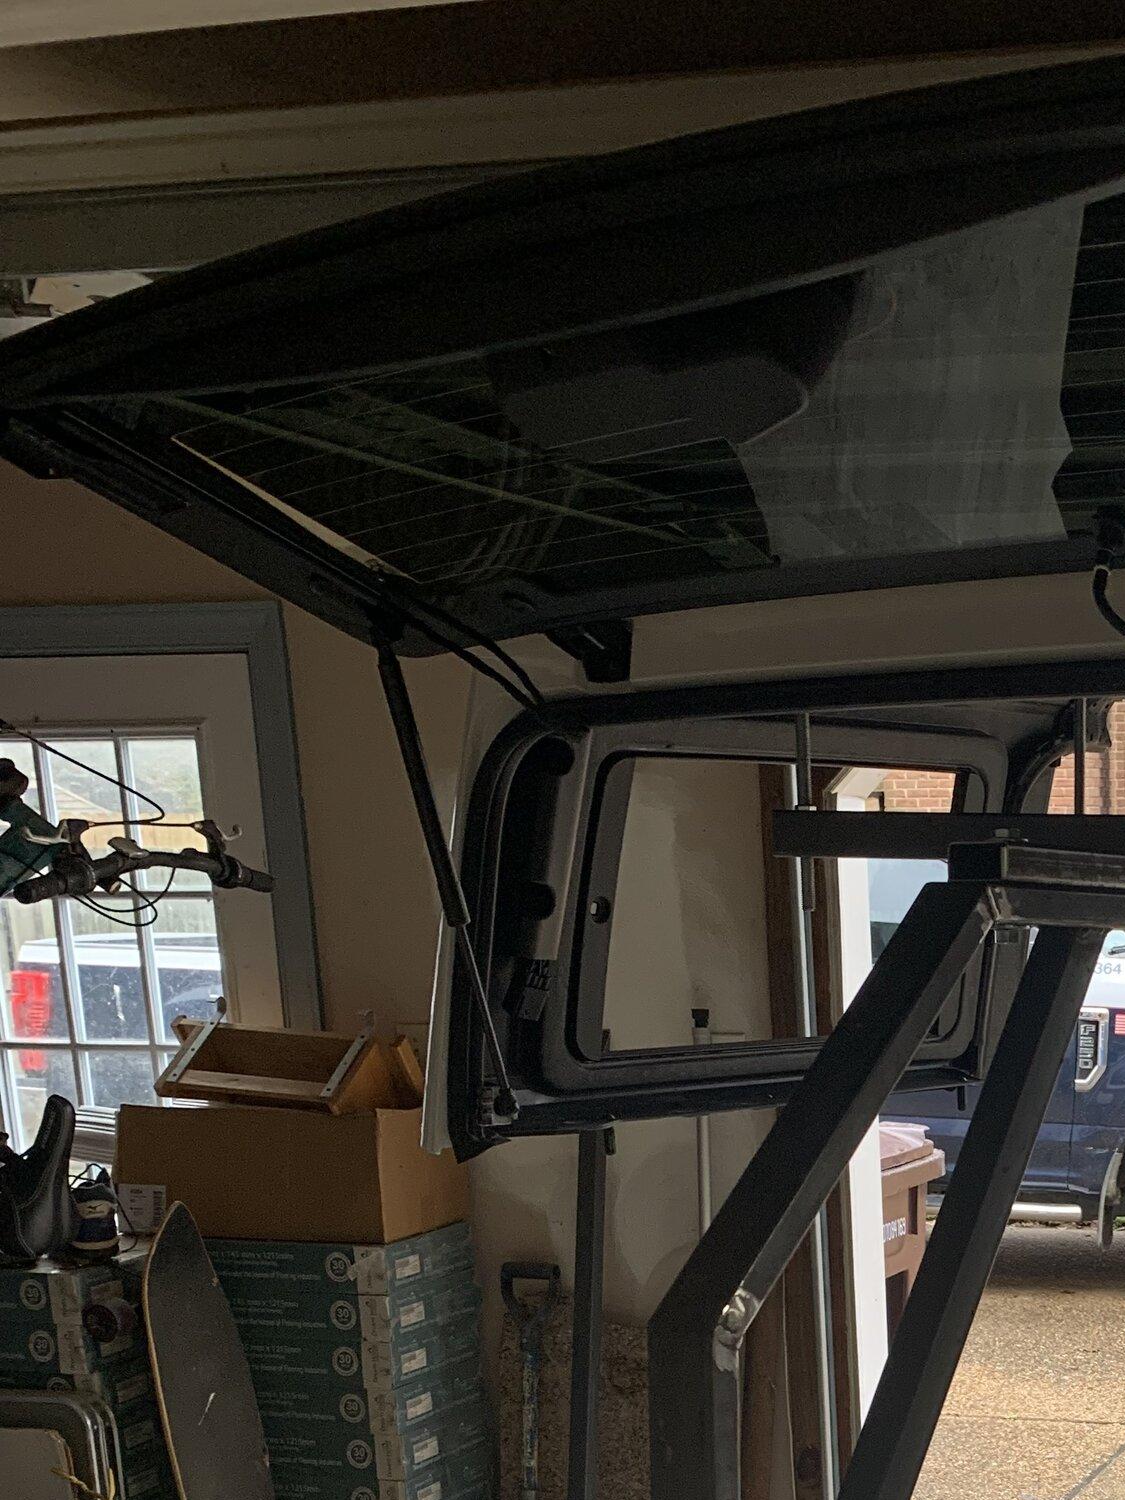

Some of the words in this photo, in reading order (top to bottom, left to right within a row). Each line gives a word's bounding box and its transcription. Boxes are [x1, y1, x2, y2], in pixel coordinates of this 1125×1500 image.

[331, 1260, 345, 1270] 30
[336, 1308, 349, 1318] 30
[338, 1354, 351, 1364] 30
[353, 1447, 366, 1457] 30
